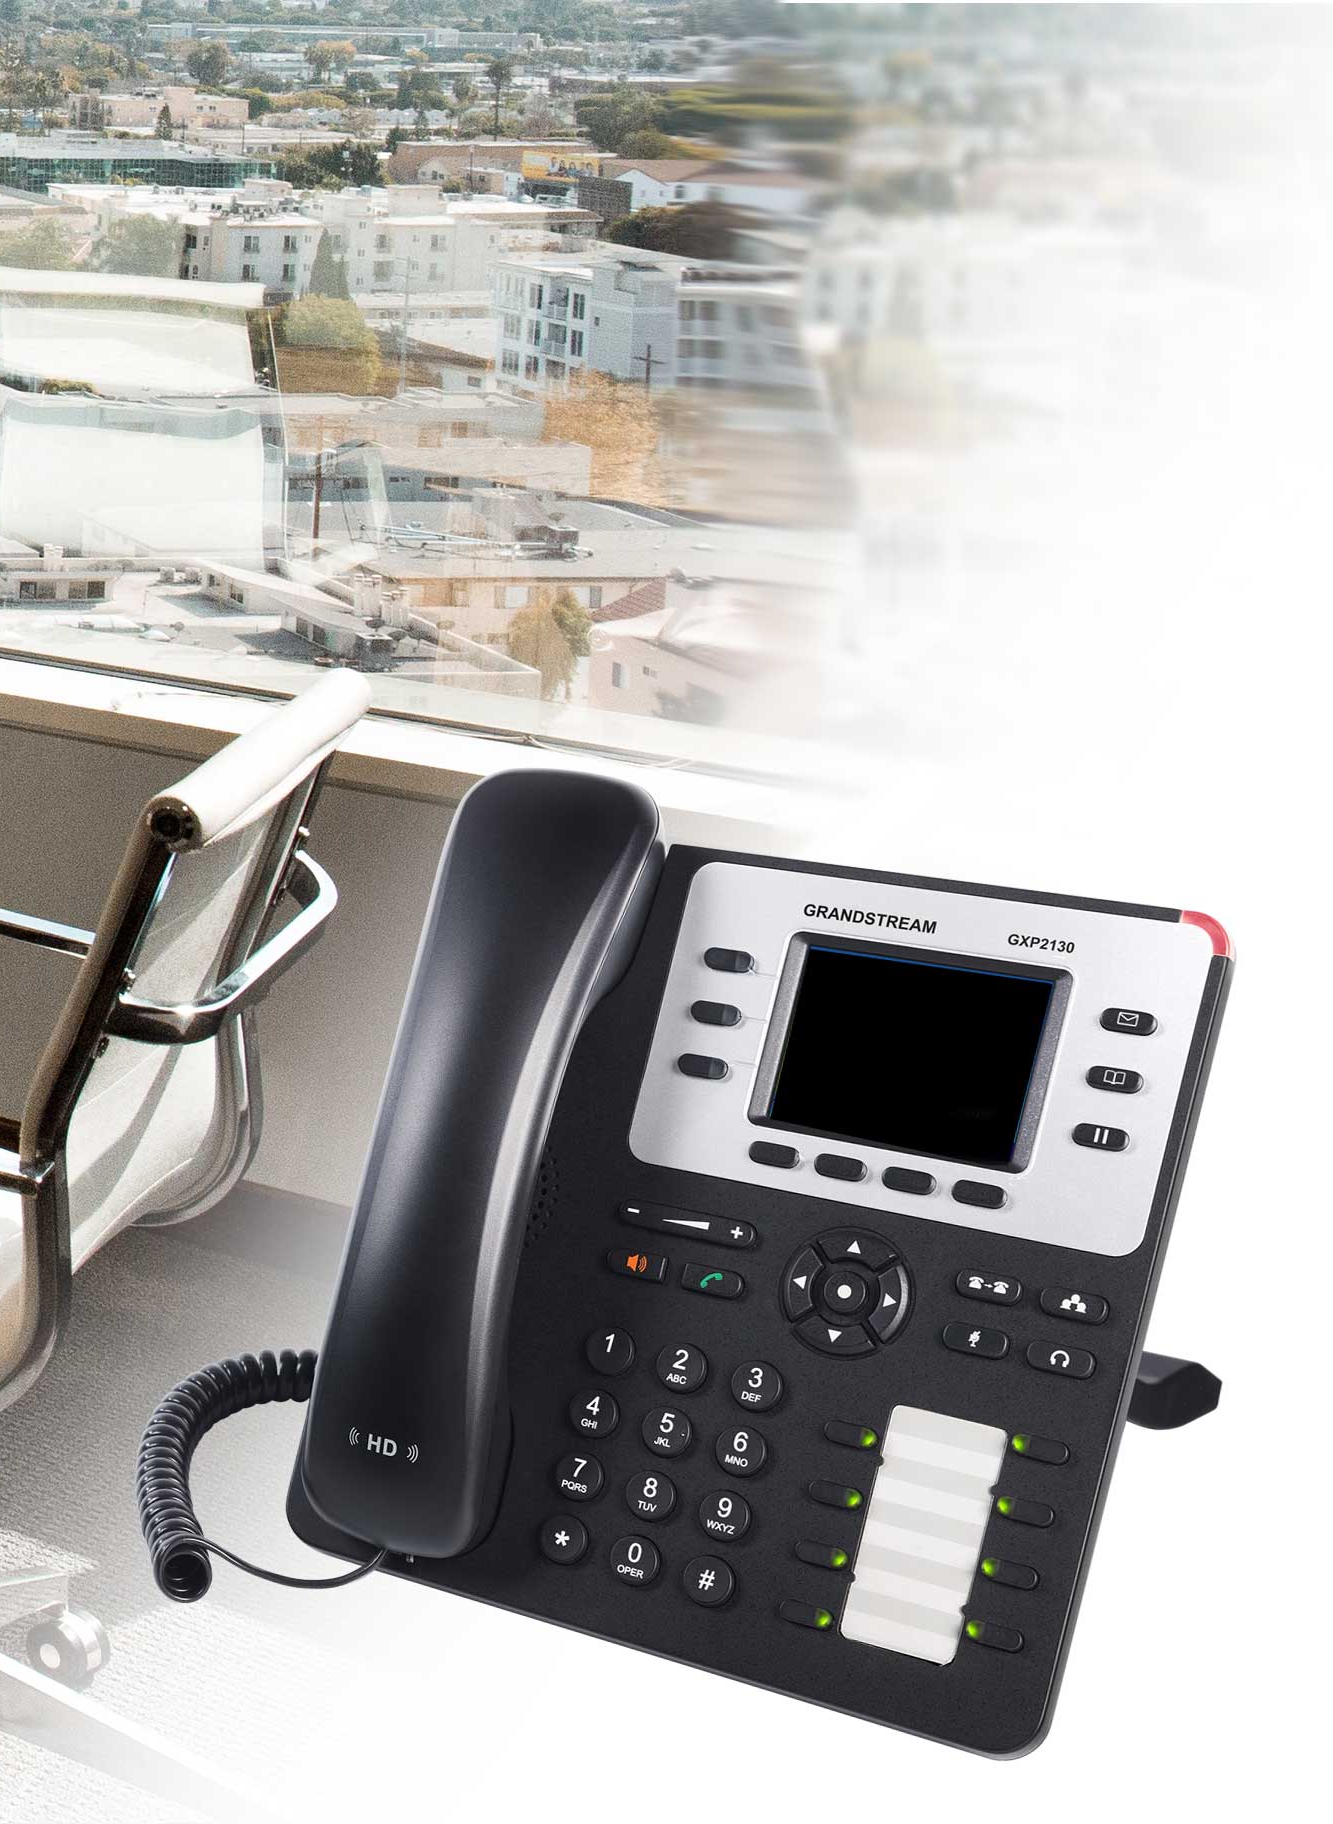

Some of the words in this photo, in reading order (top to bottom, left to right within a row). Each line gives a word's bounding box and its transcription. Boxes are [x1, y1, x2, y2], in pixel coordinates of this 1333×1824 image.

[803, 903, 937, 935] GRANDSTREAM
[1007, 933, 1075, 954] GXP2130
[604, 1333, 616, 1353] 1
[672, 1349, 689, 1371] 2
[665, 1372, 688, 1385] ABC
[747, 1367, 764, 1389] 3
[585, 1395, 600, 1416] 4
[740, 1390, 763, 1403] DEF
[580, 1418, 598, 1430] GHI
[659, 1412, 676, 1434] 5
[367, 1433, 398, 1457] HD
[653, 1436, 671, 1448] JKL
[733, 1431, 749, 1453] 6
[573, 1457, 588, 1478] 7
[724, 1453, 749, 1468] MNO
[560, 1478, 588, 1494] PQRS
[642, 1477, 658, 1498] 8
[637, 1499, 658, 1513] TUV
[716, 1497, 733, 1519] 9
[706, 1519, 735, 1535] WXYZ
[627, 1542, 643, 1564] 0
[616, 1563, 644, 1580] OPER
[698, 1569, 716, 1591] #
